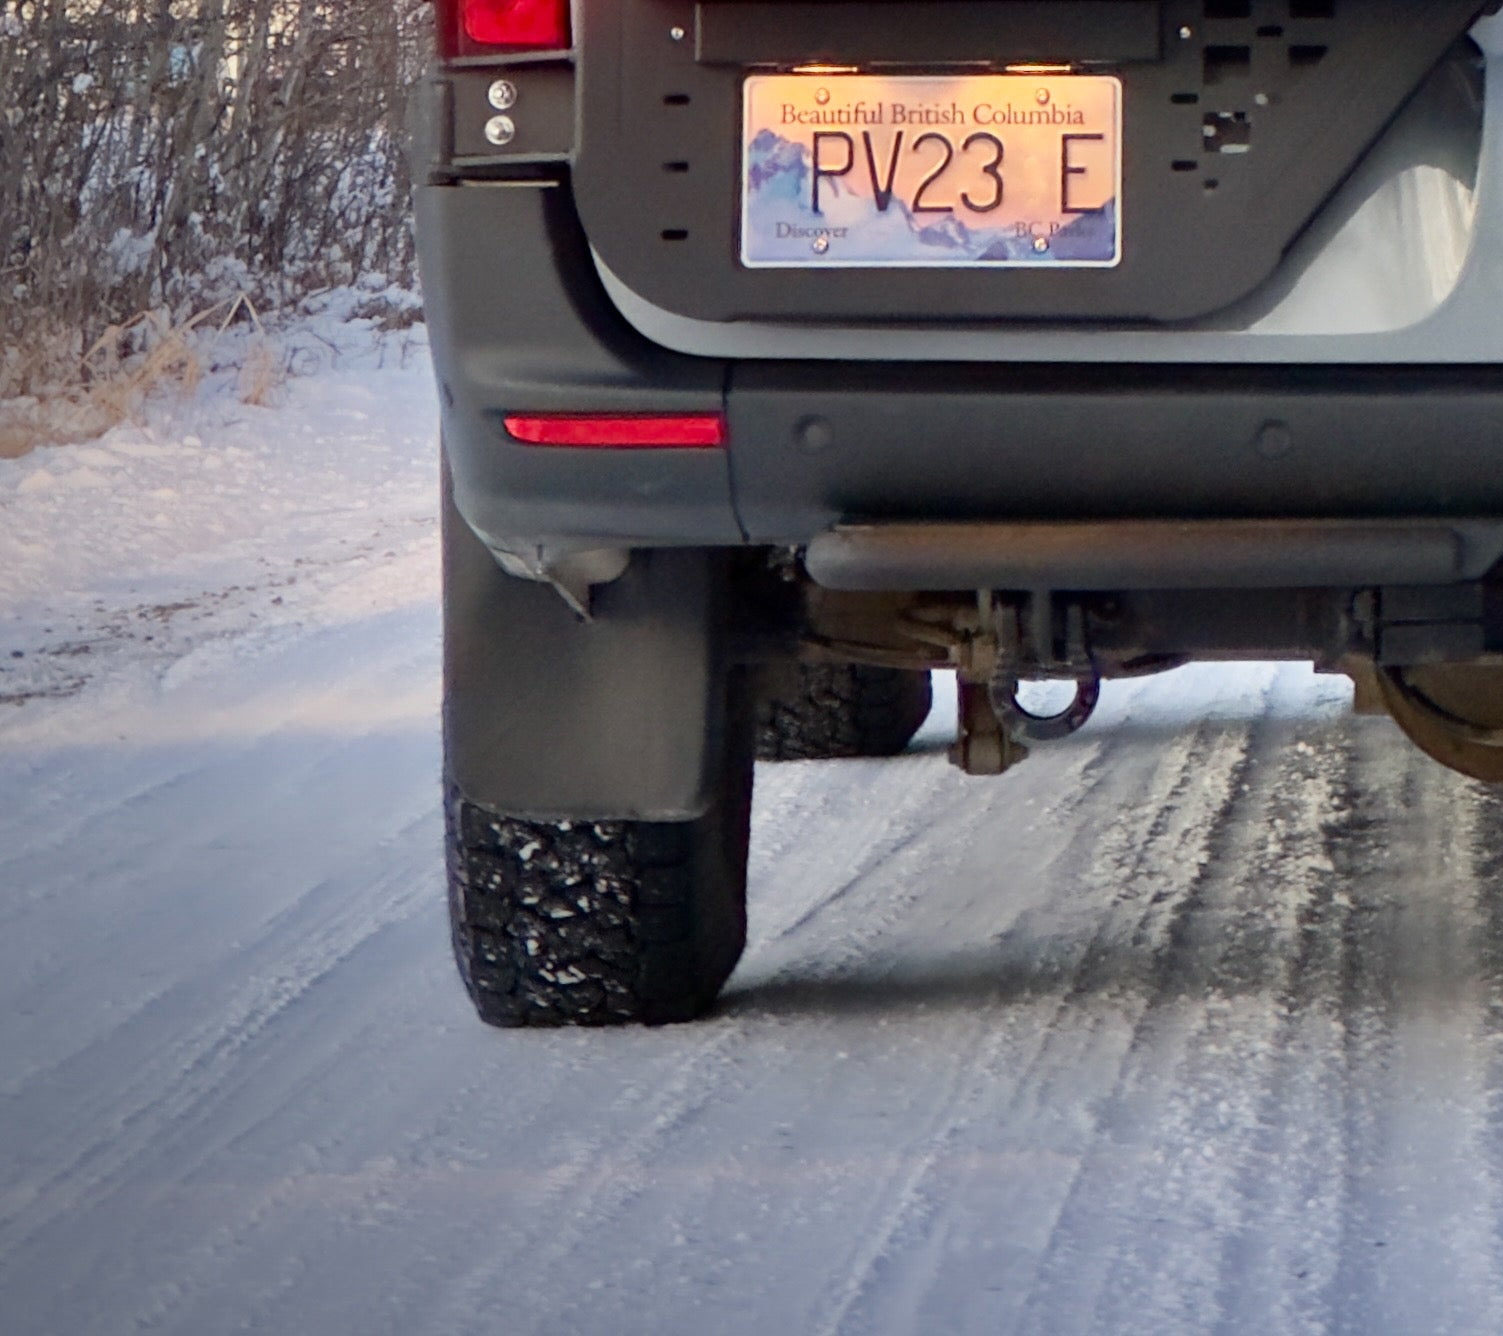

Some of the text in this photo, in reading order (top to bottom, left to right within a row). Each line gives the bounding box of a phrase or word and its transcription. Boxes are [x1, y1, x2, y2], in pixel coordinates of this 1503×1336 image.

[780, 101, 1085, 125] Beautiful British Columbia
[811, 130, 1105, 216] PV23 E
[775, 221, 849, 239] Discover
